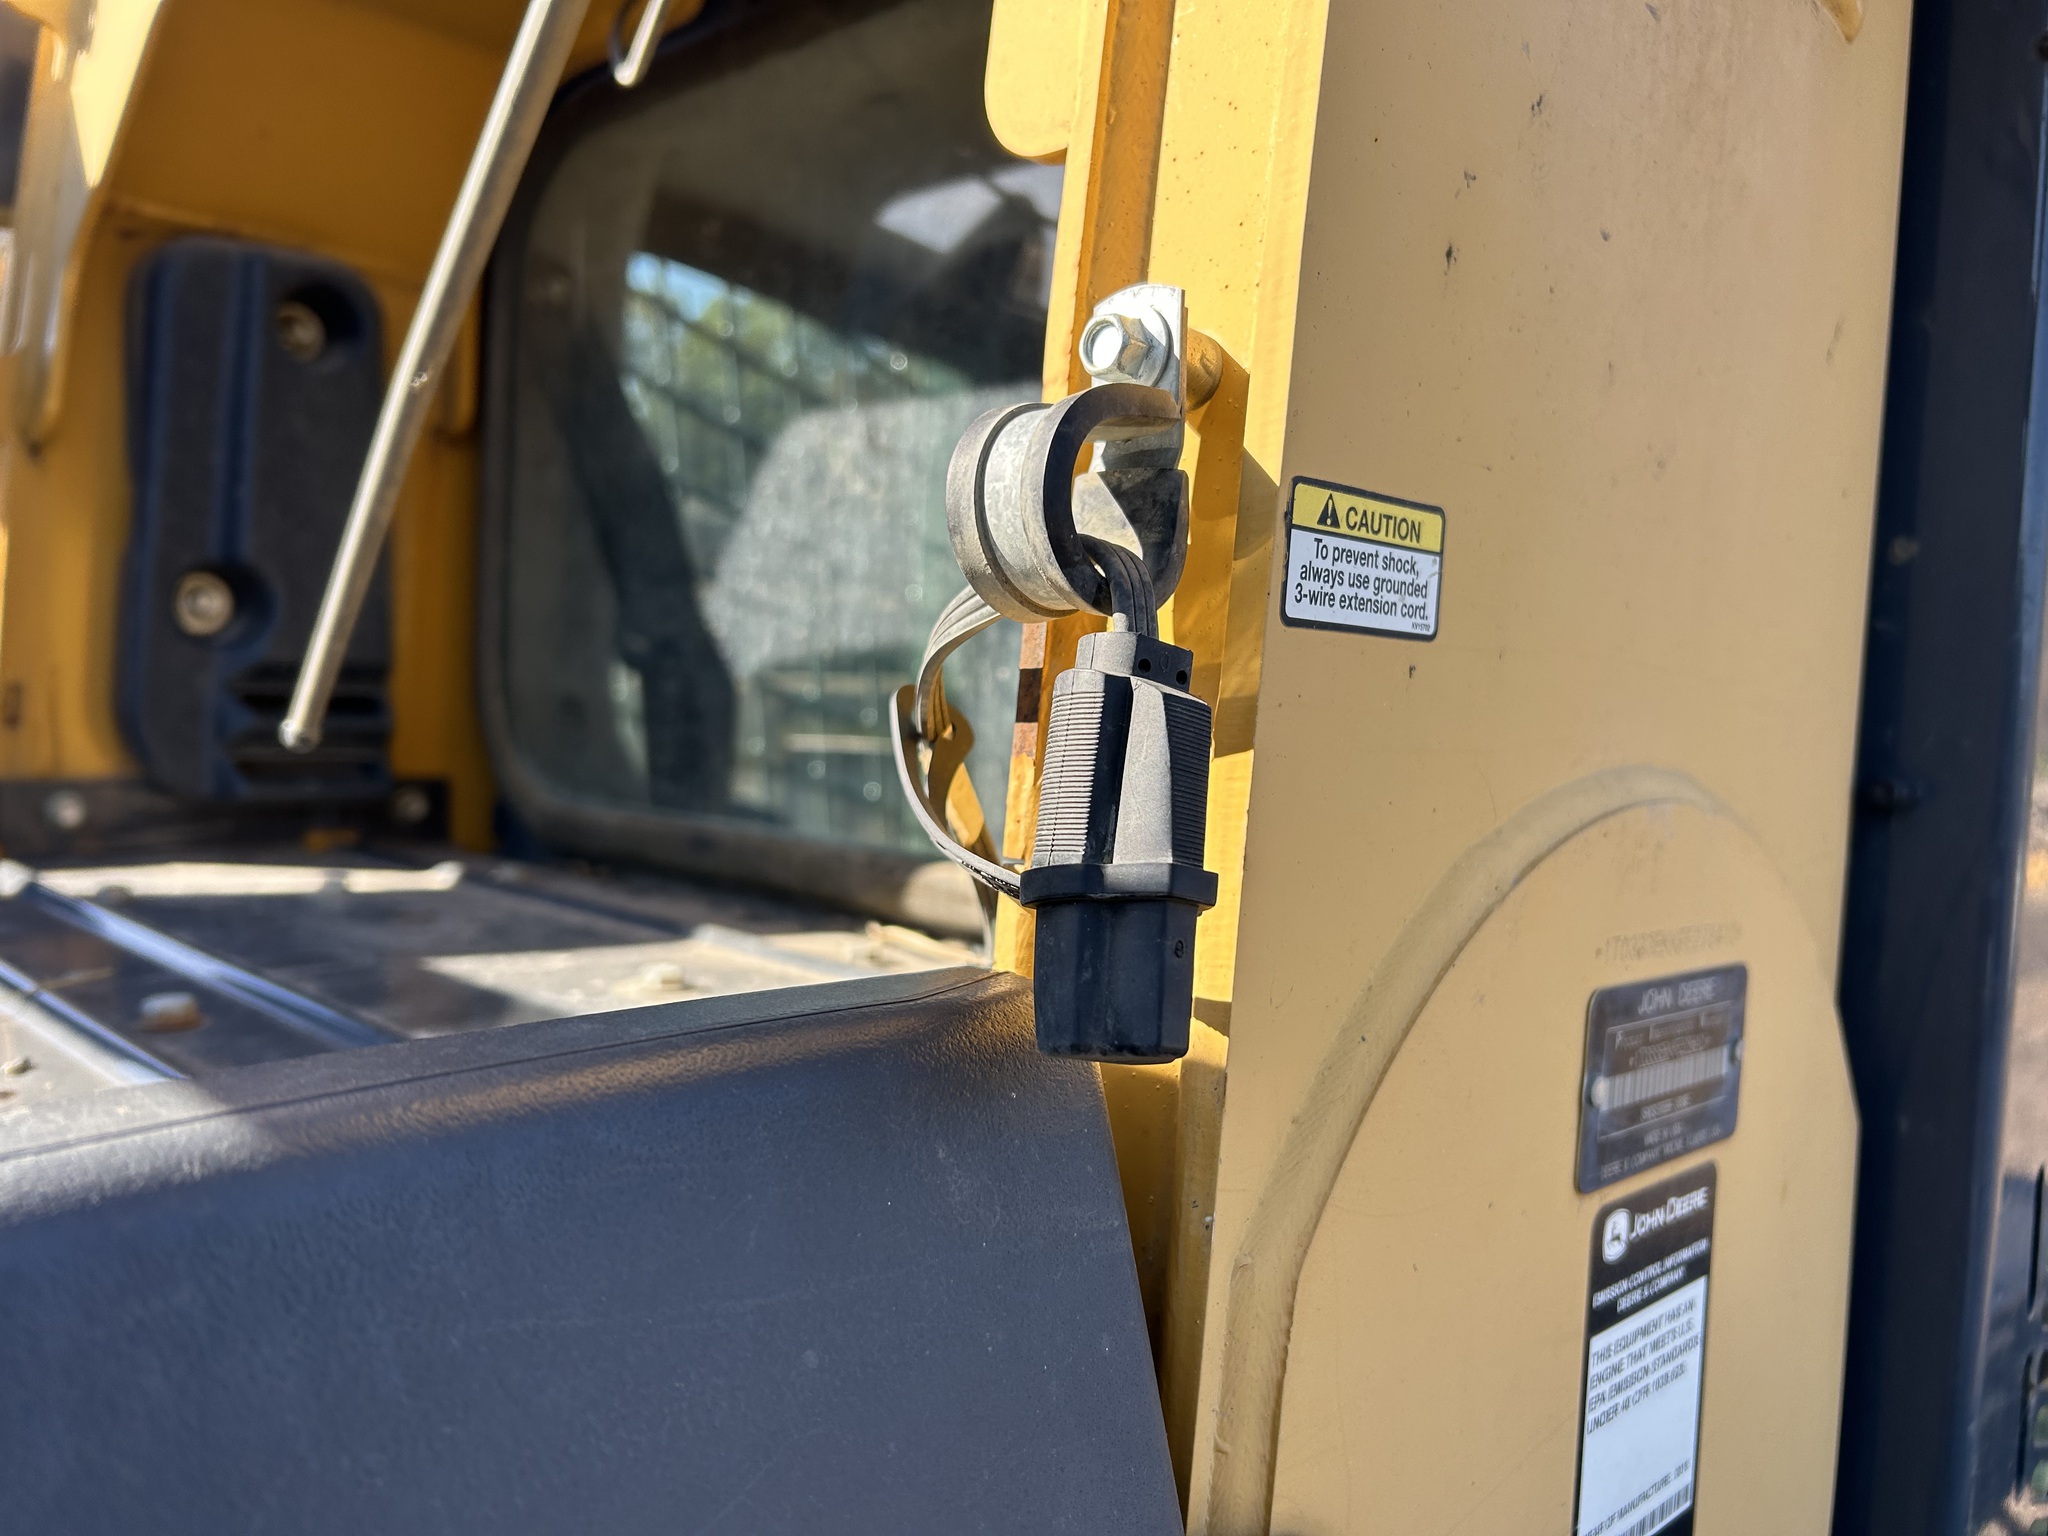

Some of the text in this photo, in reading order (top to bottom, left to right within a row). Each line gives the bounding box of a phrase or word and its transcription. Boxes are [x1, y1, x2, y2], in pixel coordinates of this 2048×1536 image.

[1345, 506, 1422, 543] CAUTION
[1314, 537, 1420, 578] To prevent shock,
[1294, 582, 1429, 621] 3-wire extension cord.
[1300, 561, 1428, 599] always use grounded
[1637, 976, 1717, 1016] JOHN DEERE
[1630, 1186, 1709, 1240] JOHN DEERE
[1592, 1238, 1709, 1309] EMISSION CONTROL INFORMATION
[1616, 1288, 1643, 1313] DEERE
[1648, 1265, 1686, 1296] COMPANY
[1590, 1358, 1626, 1391] ENGINE
[1626, 1346, 1649, 1370] THAT
[1649, 1329, 1679, 1356] MEETS
[1591, 1344, 1614, 1369] THIS
[1613, 1315, 1664, 1357] EQUIPMENT
[1664, 1307, 1681, 1329] HAS
[1588, 1335, 1700, 1413] EPA EMISSION STANDARDS
[1586, 1406, 1621, 1435] UNDER
